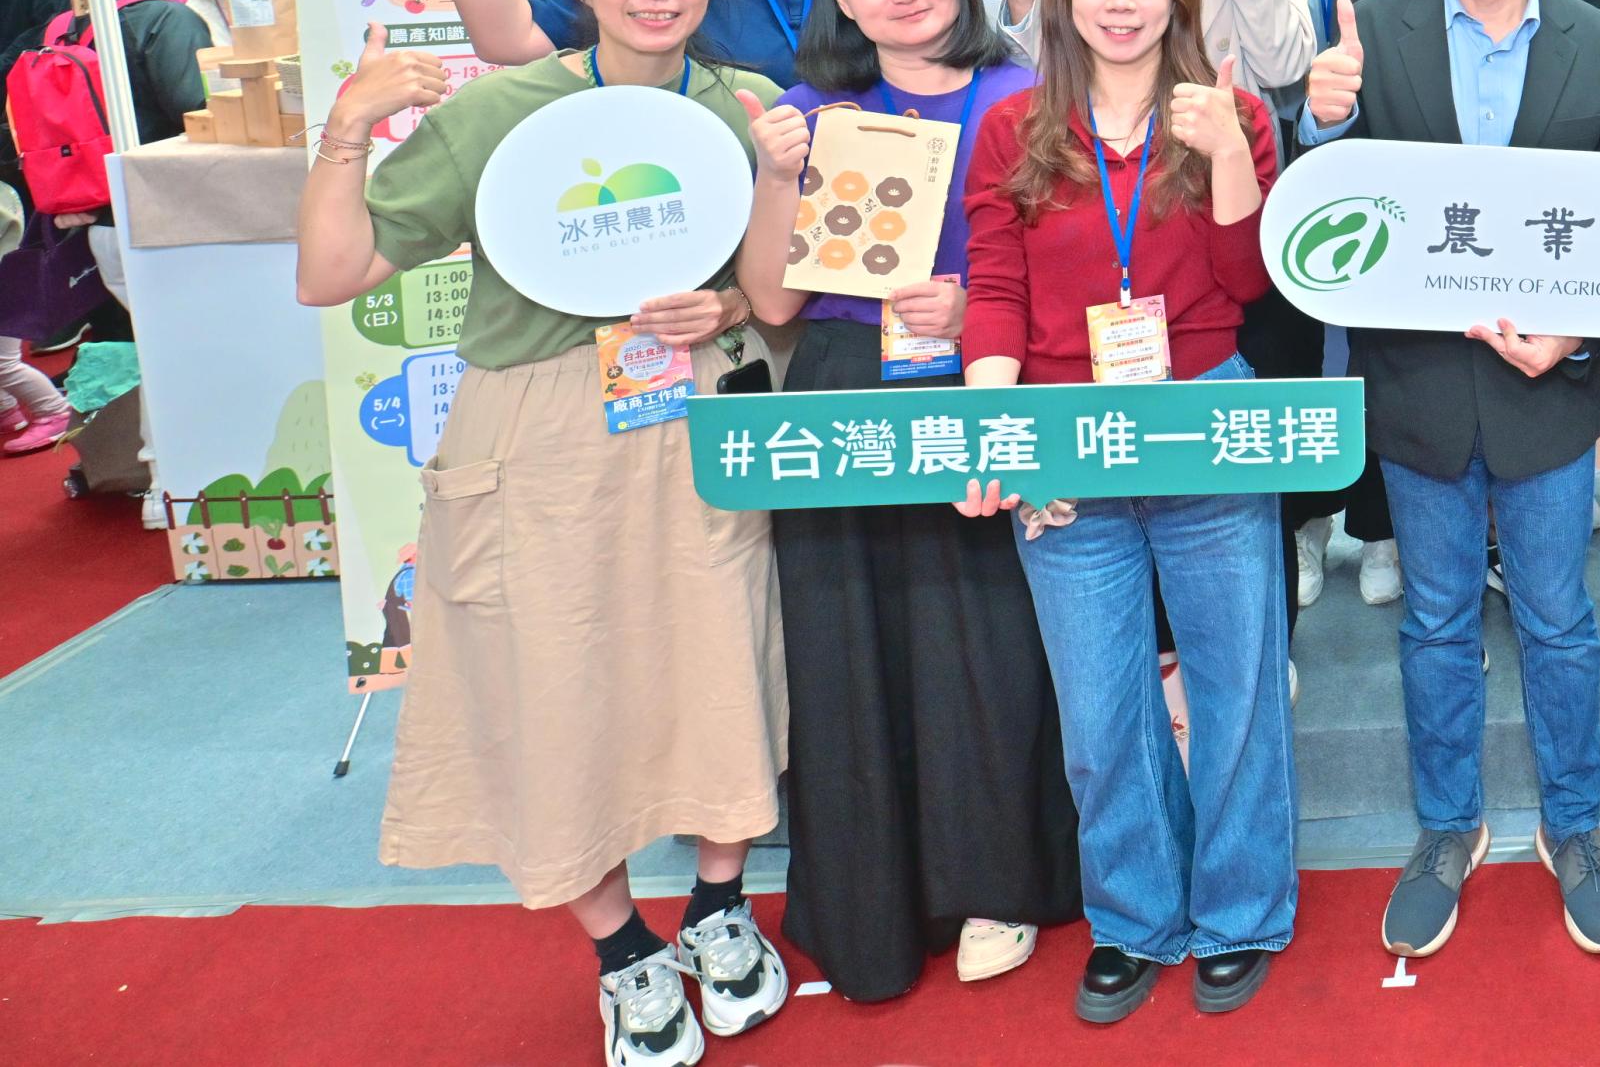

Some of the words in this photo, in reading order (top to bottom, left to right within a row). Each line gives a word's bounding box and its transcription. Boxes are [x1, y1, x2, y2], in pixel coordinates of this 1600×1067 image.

[389, 26, 469, 43] 農產知識
[558, 200, 685, 244] 冰果農場
[1425, 274, 1513, 293] MINISTRY
[1519, 278, 1545, 294] OF
[366, 294, 394, 308] 5/3
[373, 396, 401, 411] 5/4
[720, 413, 1041, 481] #台灣農產
[1076, 407, 1340, 468] 唯一選擇
